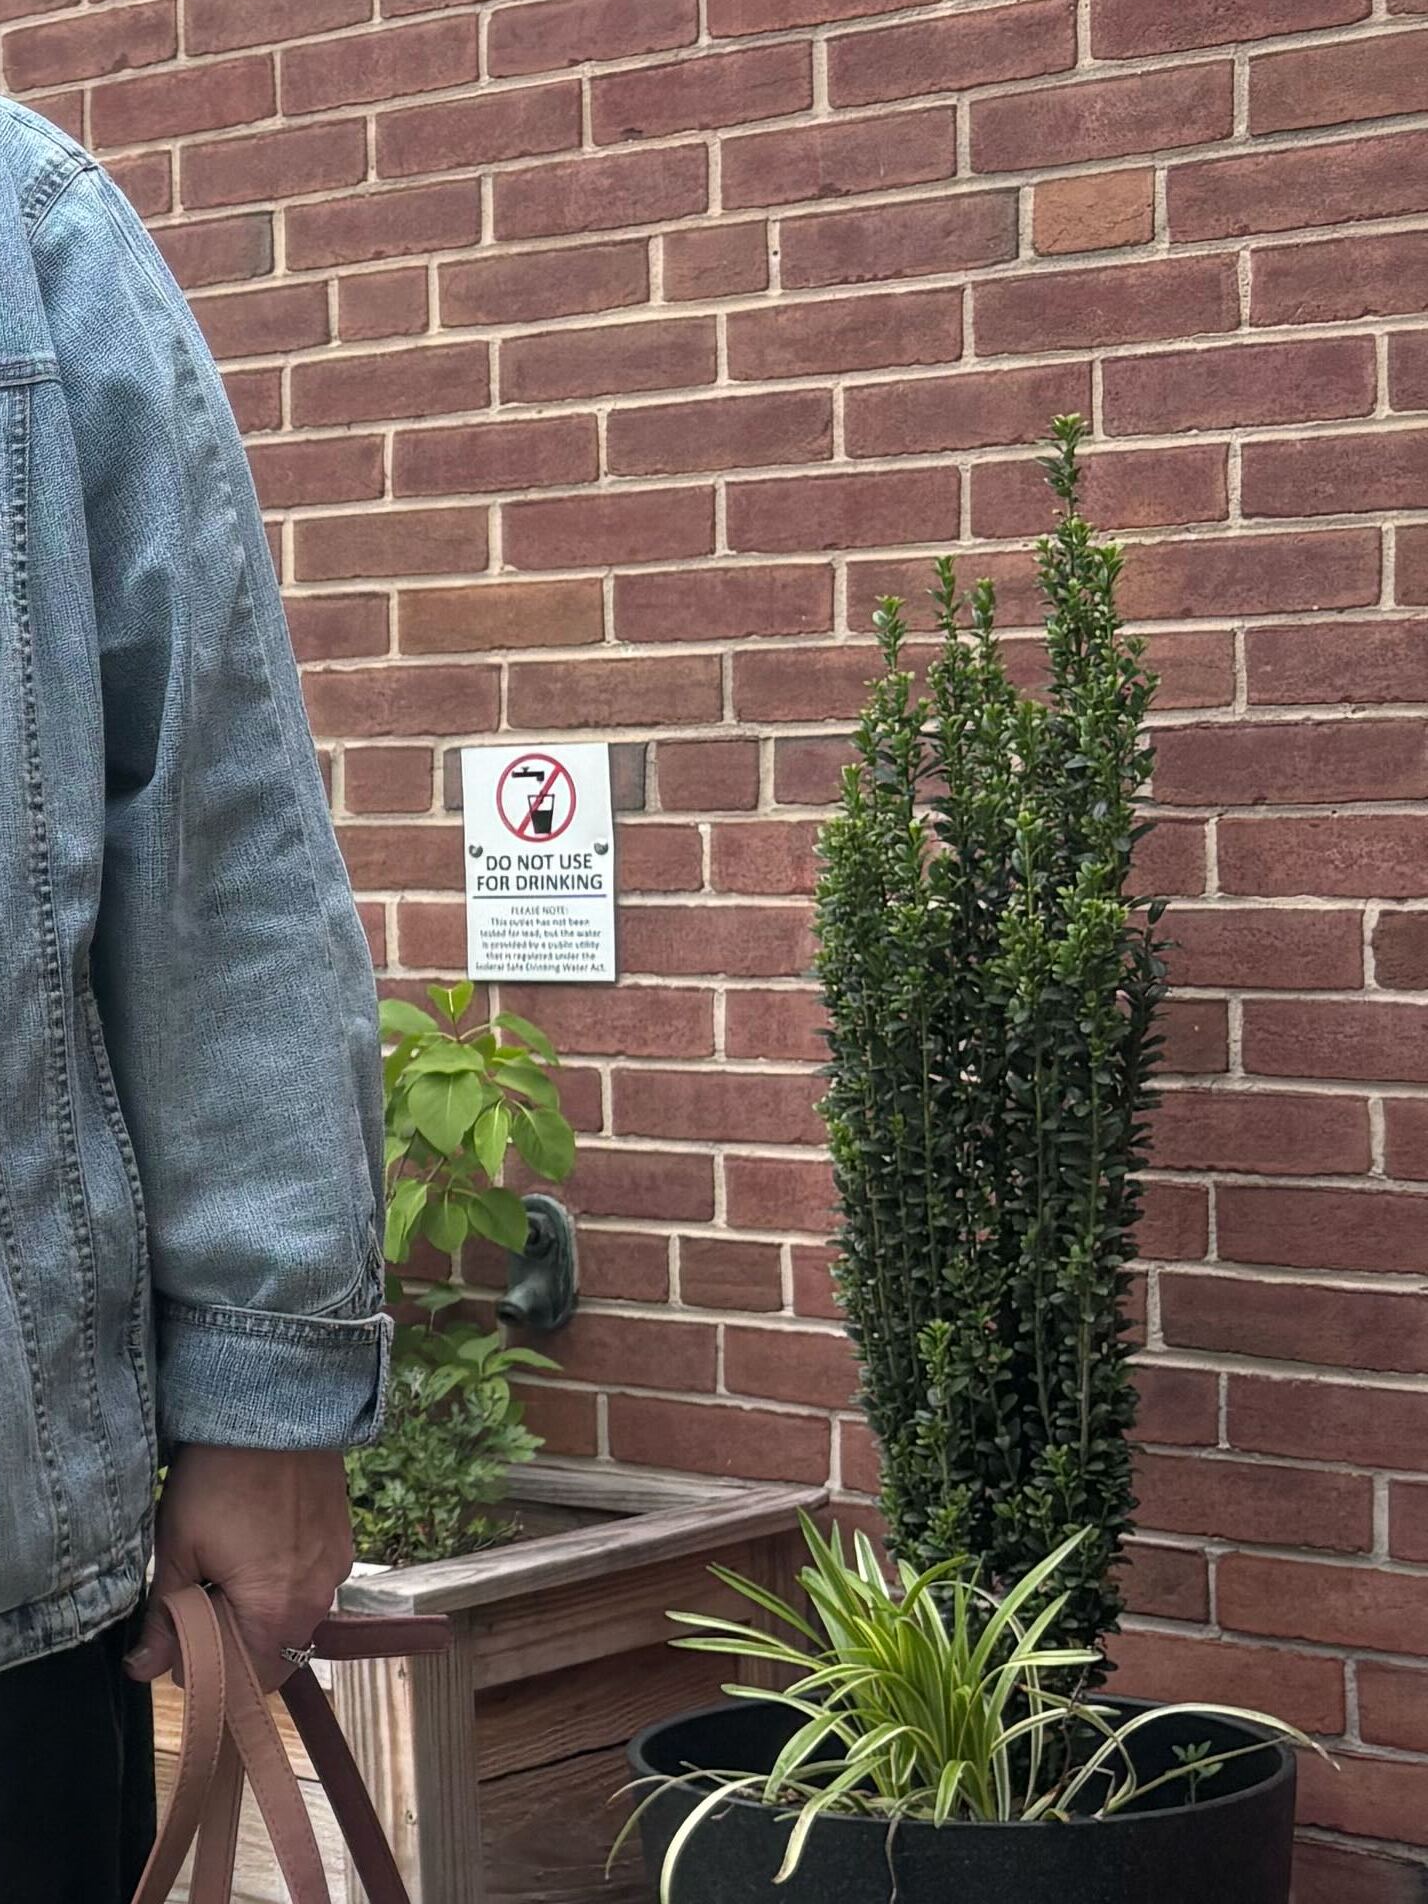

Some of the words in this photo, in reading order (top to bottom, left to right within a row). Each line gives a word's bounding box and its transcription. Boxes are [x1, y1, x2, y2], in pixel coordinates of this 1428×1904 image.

[486, 856, 511, 871] DO
[517, 854, 554, 871] NOT
[559, 853, 592, 870] USE
[477, 876, 510, 891] FOR
[516, 874, 602, 891] DRINKING
[511, 906, 540, 915] PLEASE
